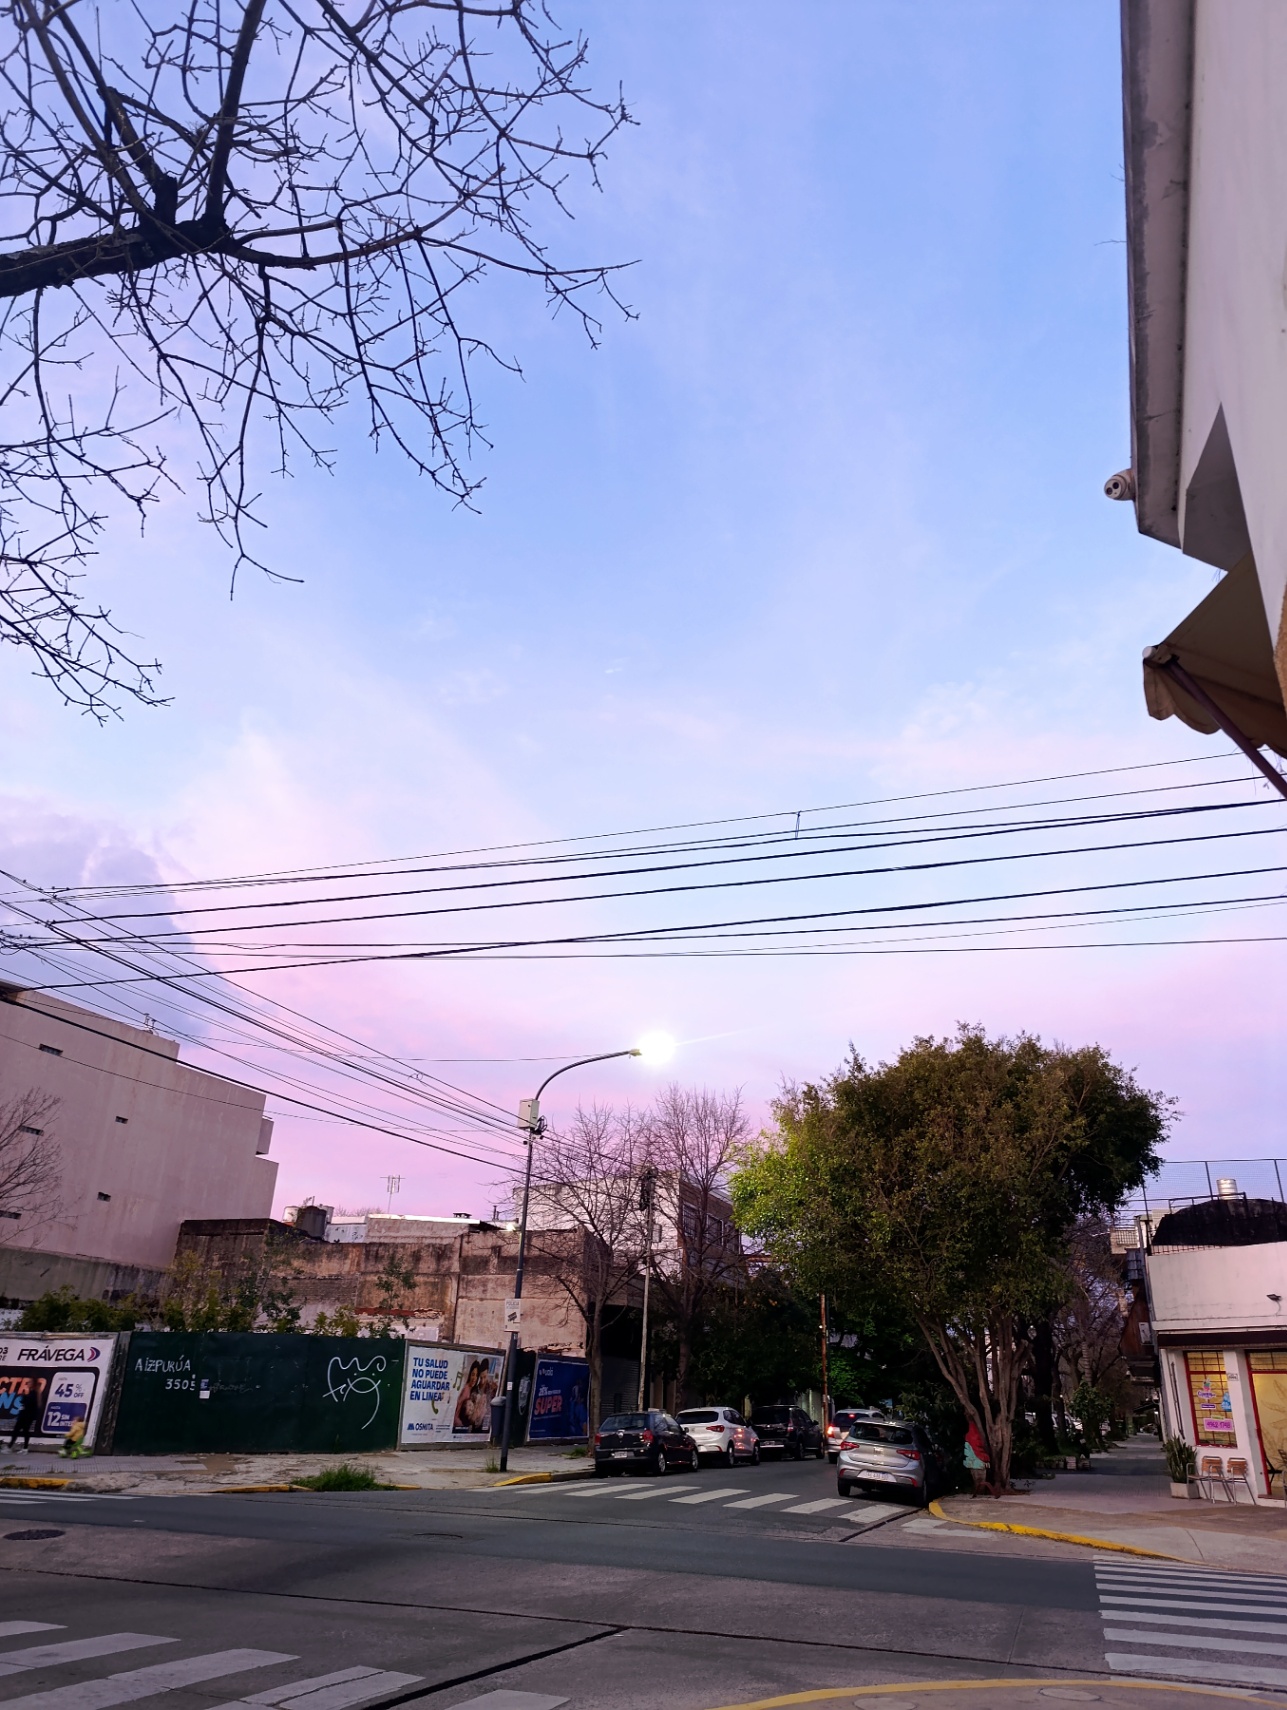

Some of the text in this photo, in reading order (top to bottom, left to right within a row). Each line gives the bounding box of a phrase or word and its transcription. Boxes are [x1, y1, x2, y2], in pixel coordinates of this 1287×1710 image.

[17, 1345, 85, 1361] FRÁVEGA
[413, 1357, 449, 1369] TU SALUD
[412, 1369, 448, 1380] NO PUEDE
[55, 1383, 74, 1398] 45
[411, 1380, 450, 1391] AGUARDAR
[410, 1391, 421, 1400] EN
[534, 1395, 563, 1416] SUPER
[47, 1411, 62, 1427] 12
